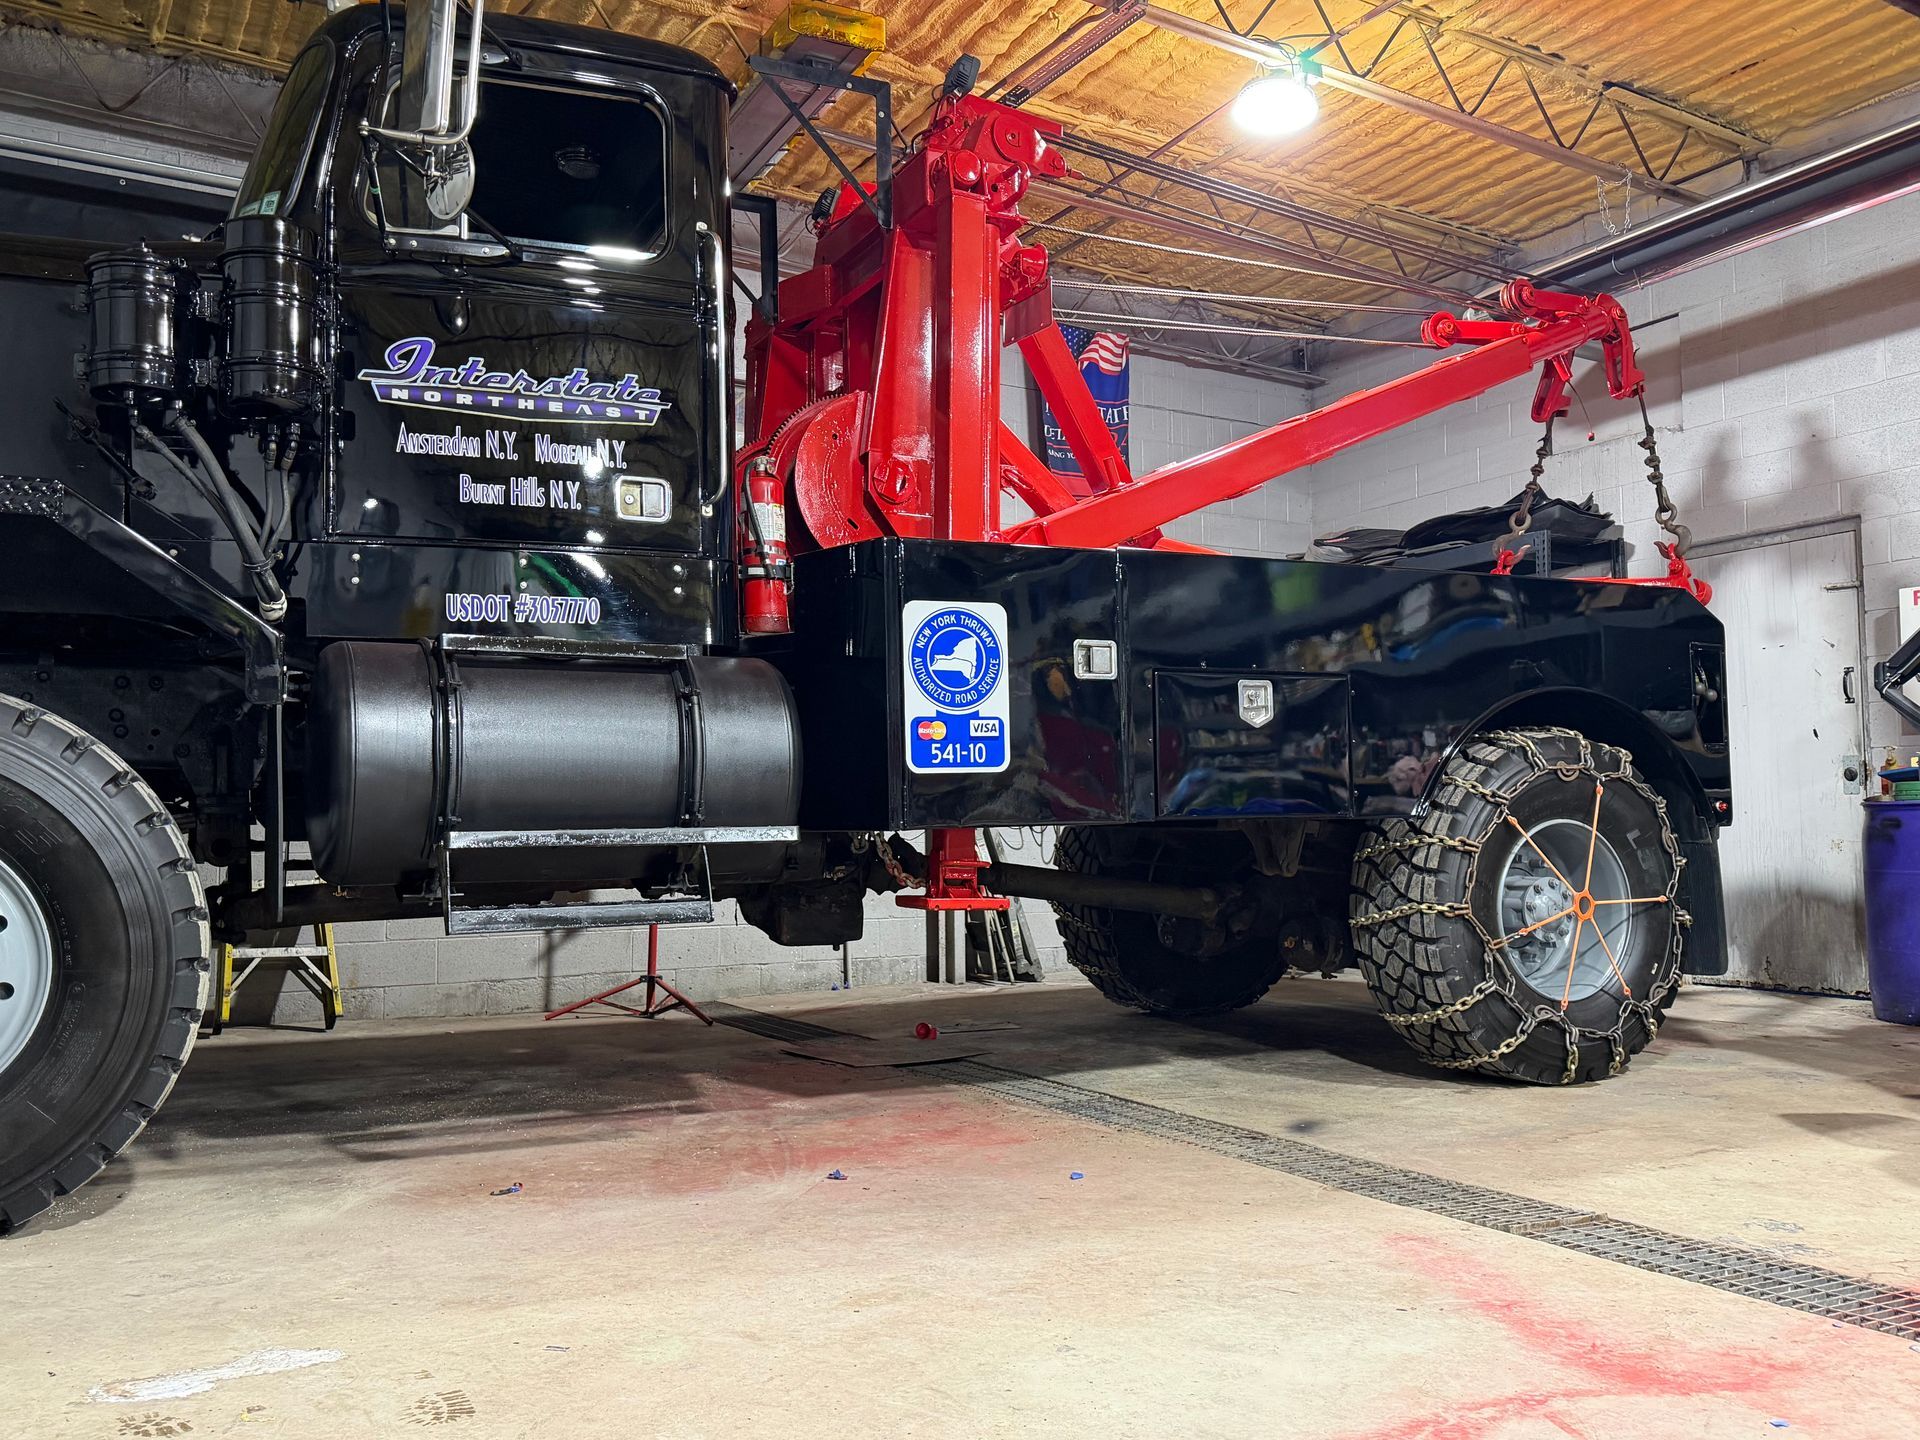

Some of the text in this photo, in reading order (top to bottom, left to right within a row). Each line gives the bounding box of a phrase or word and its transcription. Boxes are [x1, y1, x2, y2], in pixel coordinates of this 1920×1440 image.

[358, 337, 672, 408] Interstate
[391, 387, 653, 420] NORTHEAST
[486, 429, 519, 461] N.Y.
[596, 438, 628, 469] N.Y.
[510, 476, 546, 508] Hills
[550, 479, 582, 510] N.Y.
[445, 593, 600, 625] USDOT #3057770
[915, 614, 996, 649] NEW YORK THRUWAY
[913, 657, 1000, 704] AUTHORIZED ROAD SERVICE
[973, 723, 998, 733] VISA
[931, 743, 987, 764] 541-10
